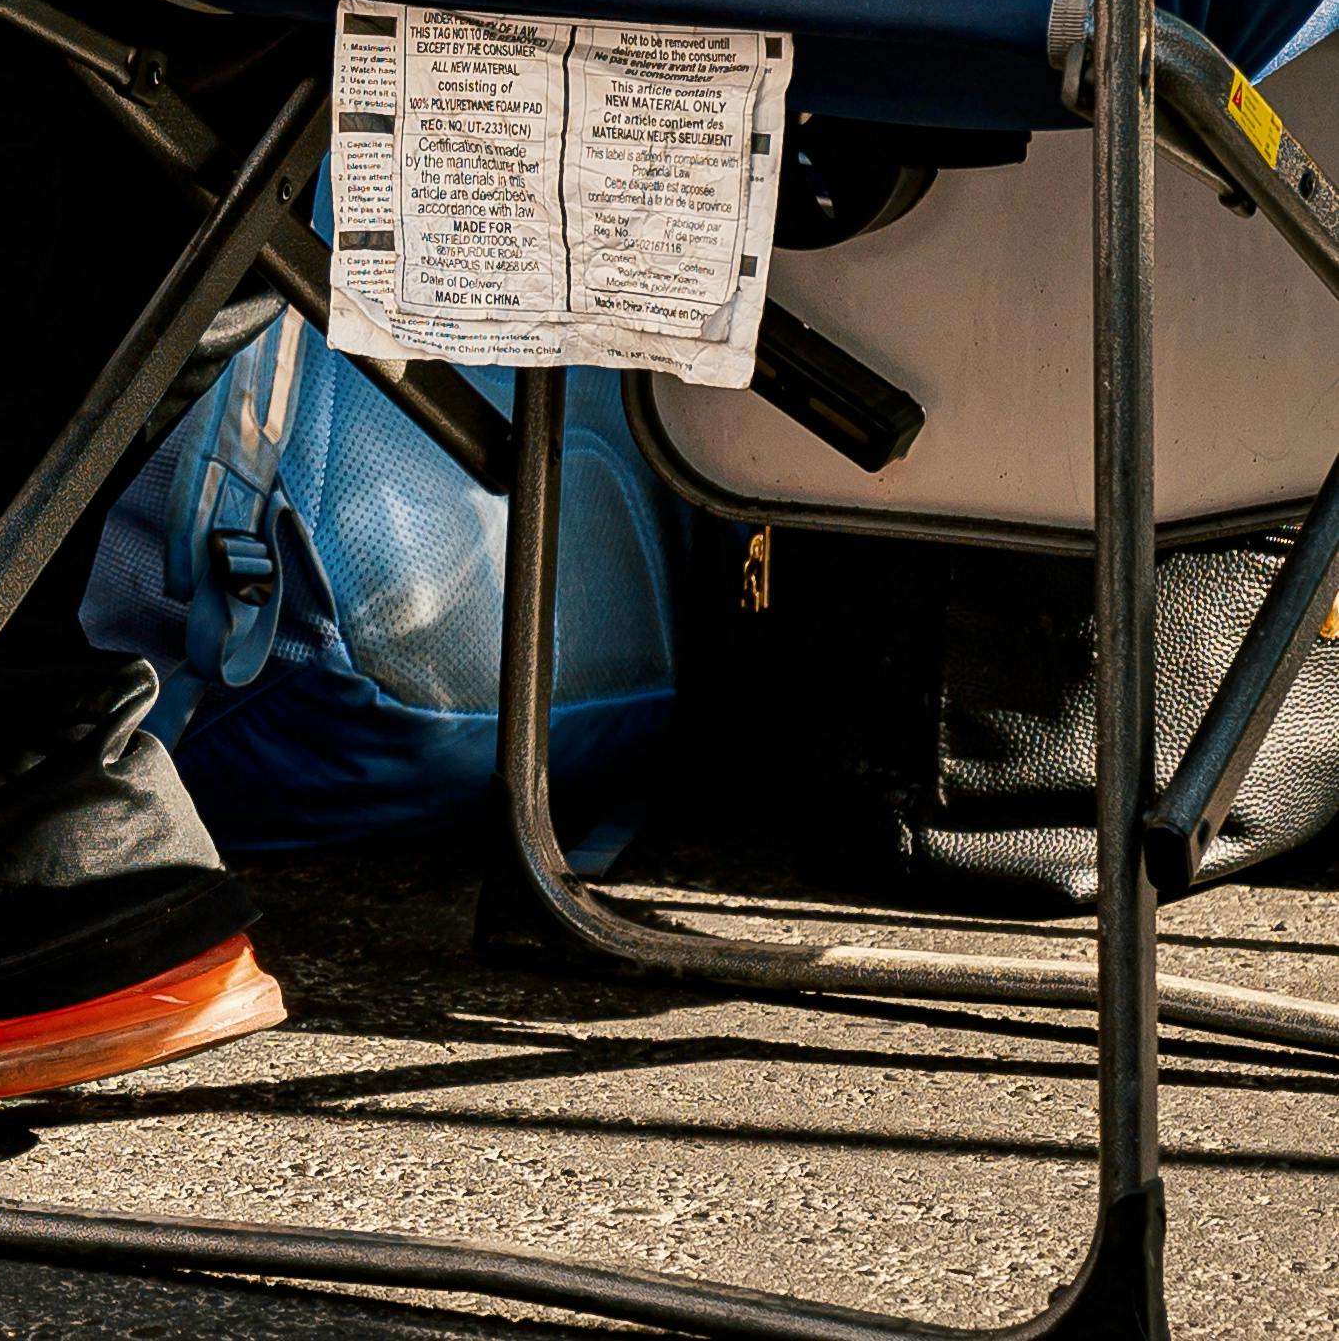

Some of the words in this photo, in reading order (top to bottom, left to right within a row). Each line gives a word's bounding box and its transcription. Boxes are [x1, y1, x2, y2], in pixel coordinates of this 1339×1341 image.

[424, 12, 453, 24] UNDER
[499, 23, 513, 34] OF
[410, 27, 430, 38] THIS
[433, 27, 450, 39] TAG
[453, 28, 468, 39] NOT
[471, 28, 482, 40] TO
[483, 30, 497, 40] BE
[497, 35, 547, 47] REMOVED
[620, 33, 637, 45] Not
[640, 35, 649, 46] to
[651, 35, 662, 47] be
[665, 36, 705, 49] removed
[708, 37, 730, 49] until
[417, 42, 451, 54] EXCEPT
[453, 43, 465, 54] BY
[467, 43, 481, 55] THE
[483, 44, 535, 57] CONSUMER
[612, 47, 656, 59] delivered
[659, 51, 670, 61] to
[671, 51, 686, 61] the
[689, 53, 737, 62] consumer
[432, 61, 448, 73] ALL
[451, 61, 471, 73] NEW
[473, 62, 520, 76] MATERIAL
[594, 51, 607, 61] Ne
[610, 55, 628, 65] pas
[630, 59, 666, 70] enlever
[668, 61, 695, 72] avant
[698, 62, 706, 72] la
[708, 62, 749, 73] livraison
[351, 66, 376, 74] Watch
[625, 68, 638, 76] au
[640, 70, 714, 82] consommateur
[350, 77, 365, 85] Use
[438, 79, 496, 96] consisting
[501, 81, 513, 93] of
[349, 87, 361, 95] Do
[611, 80, 633, 93] This
[637, 82, 672, 96] article
[675, 86, 722, 98] contains
[410, 98, 429, 110] 100%
[431, 98, 495, 111] POLYURETHANE
[496, 99, 521, 113] FOAM
[523, 100, 543, 114] PAD
[605, 94, 629, 107] NEW
[632, 96, 688, 111] MATERIAL
[693, 100, 726, 114] ONLY
[604, 112, 621, 124] Cet
[625, 114, 656, 127] article
[659, 116, 704, 130] contient
[707, 118, 724, 130] des
[421, 120, 446, 131] REG.
[449, 121, 464, 132] NO.
[468, 121, 531, 138] UT-2331(CN)
[647, 131, 676, 144] NEUFS
[678, 132, 733, 146] SEULEMENT
[419, 137, 482, 152] Certification
[484, 142, 492, 155] is
[495, 144, 526, 158] made
[406, 153, 421, 170] by
[424, 154, 443, 168] the
[447, 156, 514, 171] manufacturer
[518, 160, 539, 173] that
[586, 147, 603, 159] This
[606, 147, 625, 160] label
[627, 148, 634, 160] is
[664, 150, 672, 161] in
[673, 151, 719, 168] compliance
[721, 155, 739, 168] with
[421, 171, 440, 183] the
[444, 172, 495, 186] materials
[498, 175, 506, 186] in
[509, 176, 525, 187] this
[674, 166, 690, 179] Law
[411, 187, 446, 199] article
[450, 190, 468, 200] are
[472, 187, 526, 201] described
[526, 193, 536, 203] in
[418, 203, 486, 215] accordance
[489, 205, 511, 217] with
[515, 204, 535, 218] law
[676, 194, 686, 207] de
[689, 197, 695, 209] la
[697, 199, 732, 213] province
[454, 220, 486, 233] MADE
[489, 222, 511, 233] FOR
[618, 214, 630, 226] by
[708, 223, 722, 233] par
[421, 233, 470, 244] WESTFIELD
[689, 234, 718, 245] permis
[457, 247, 496, 257] PURDUE
[498, 248, 522, 259] ROAD
[485, 261, 494, 270] IN
[521, 262, 540, 271] USA
[421, 272, 444, 284] Date
[447, 276, 456, 286] of
[460, 277, 502, 291] Delivery
[435, 291, 468, 304] MADE
[471, 293, 482, 304] IN
[486, 294, 520, 306] CHINA
[679, 310, 688, 320] en
[459, 344, 485, 353] Chine
